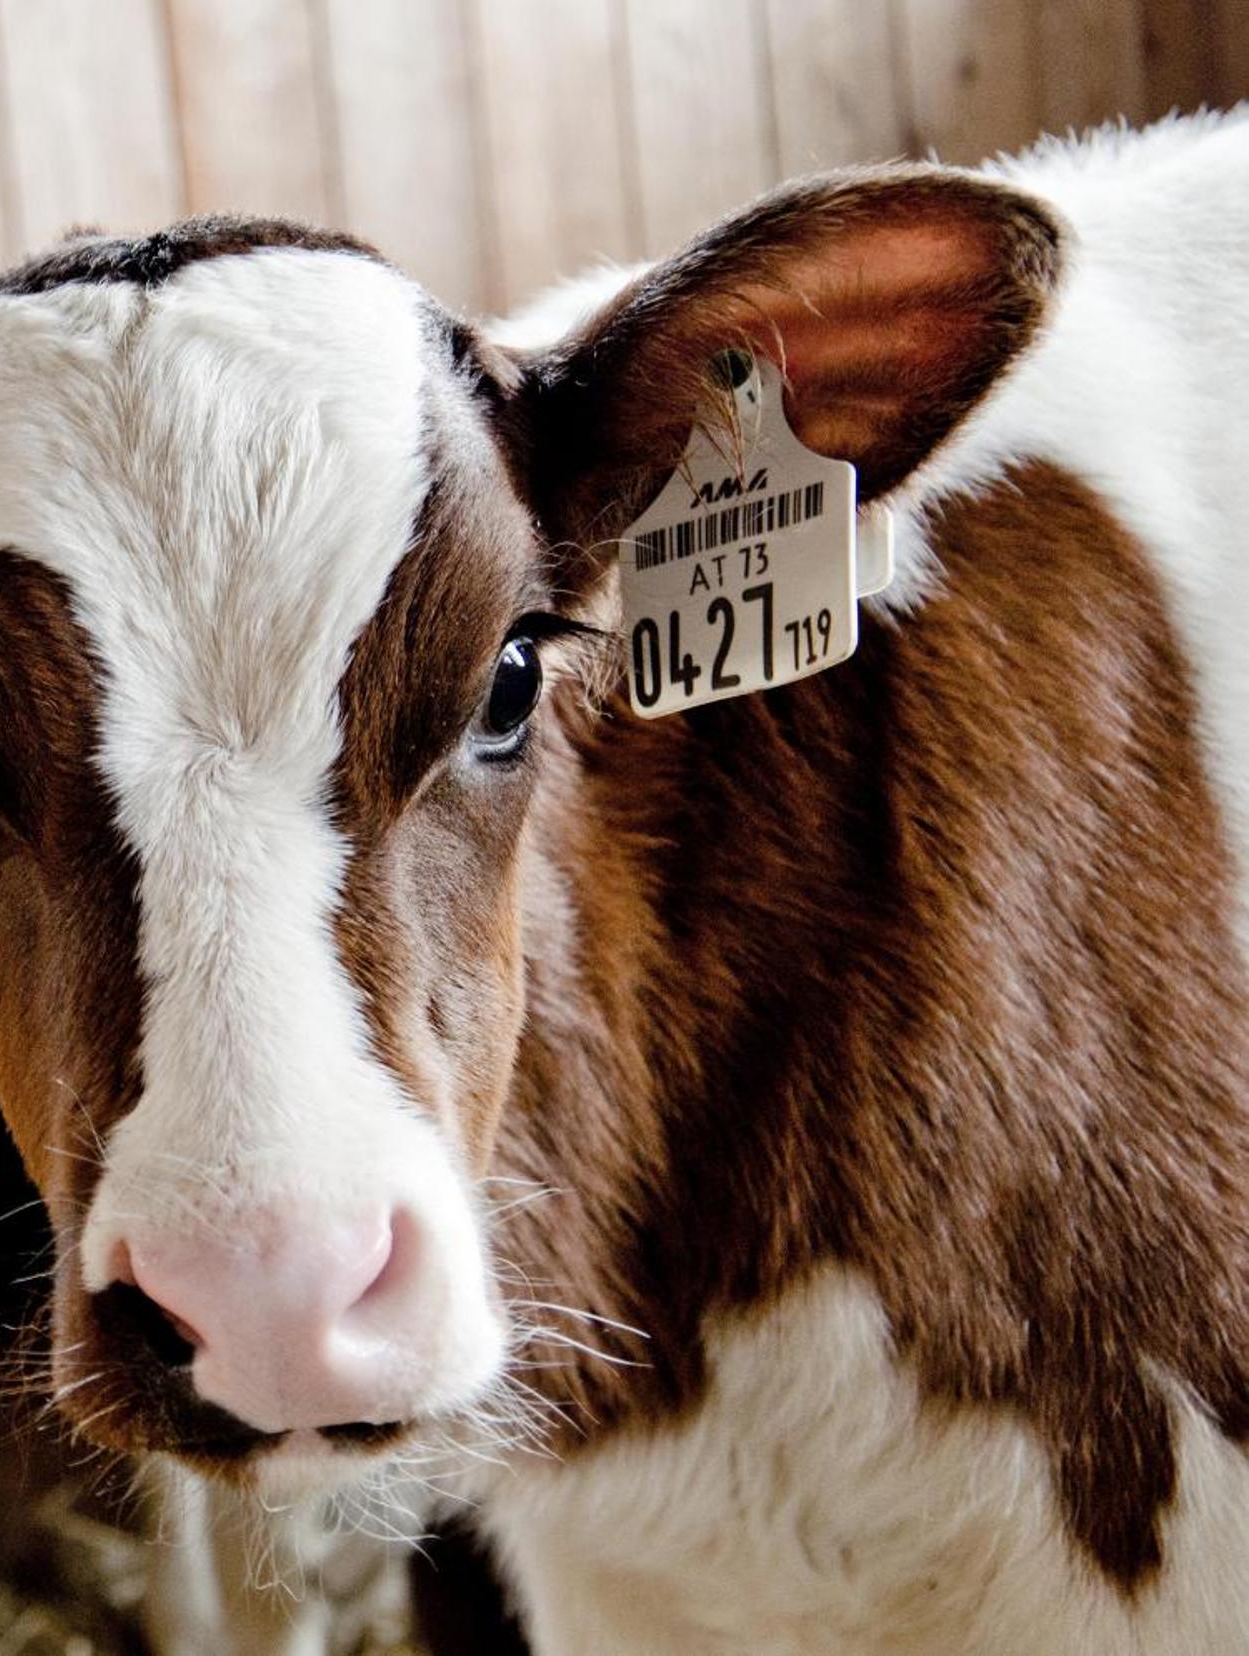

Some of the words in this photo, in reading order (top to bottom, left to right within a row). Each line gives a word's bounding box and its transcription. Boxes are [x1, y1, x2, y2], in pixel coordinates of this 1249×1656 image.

[689, 555, 727, 595] AT
[739, 543, 769, 578] 73
[632, 582, 773, 707] 0427
[785, 608, 831, 671] 719
